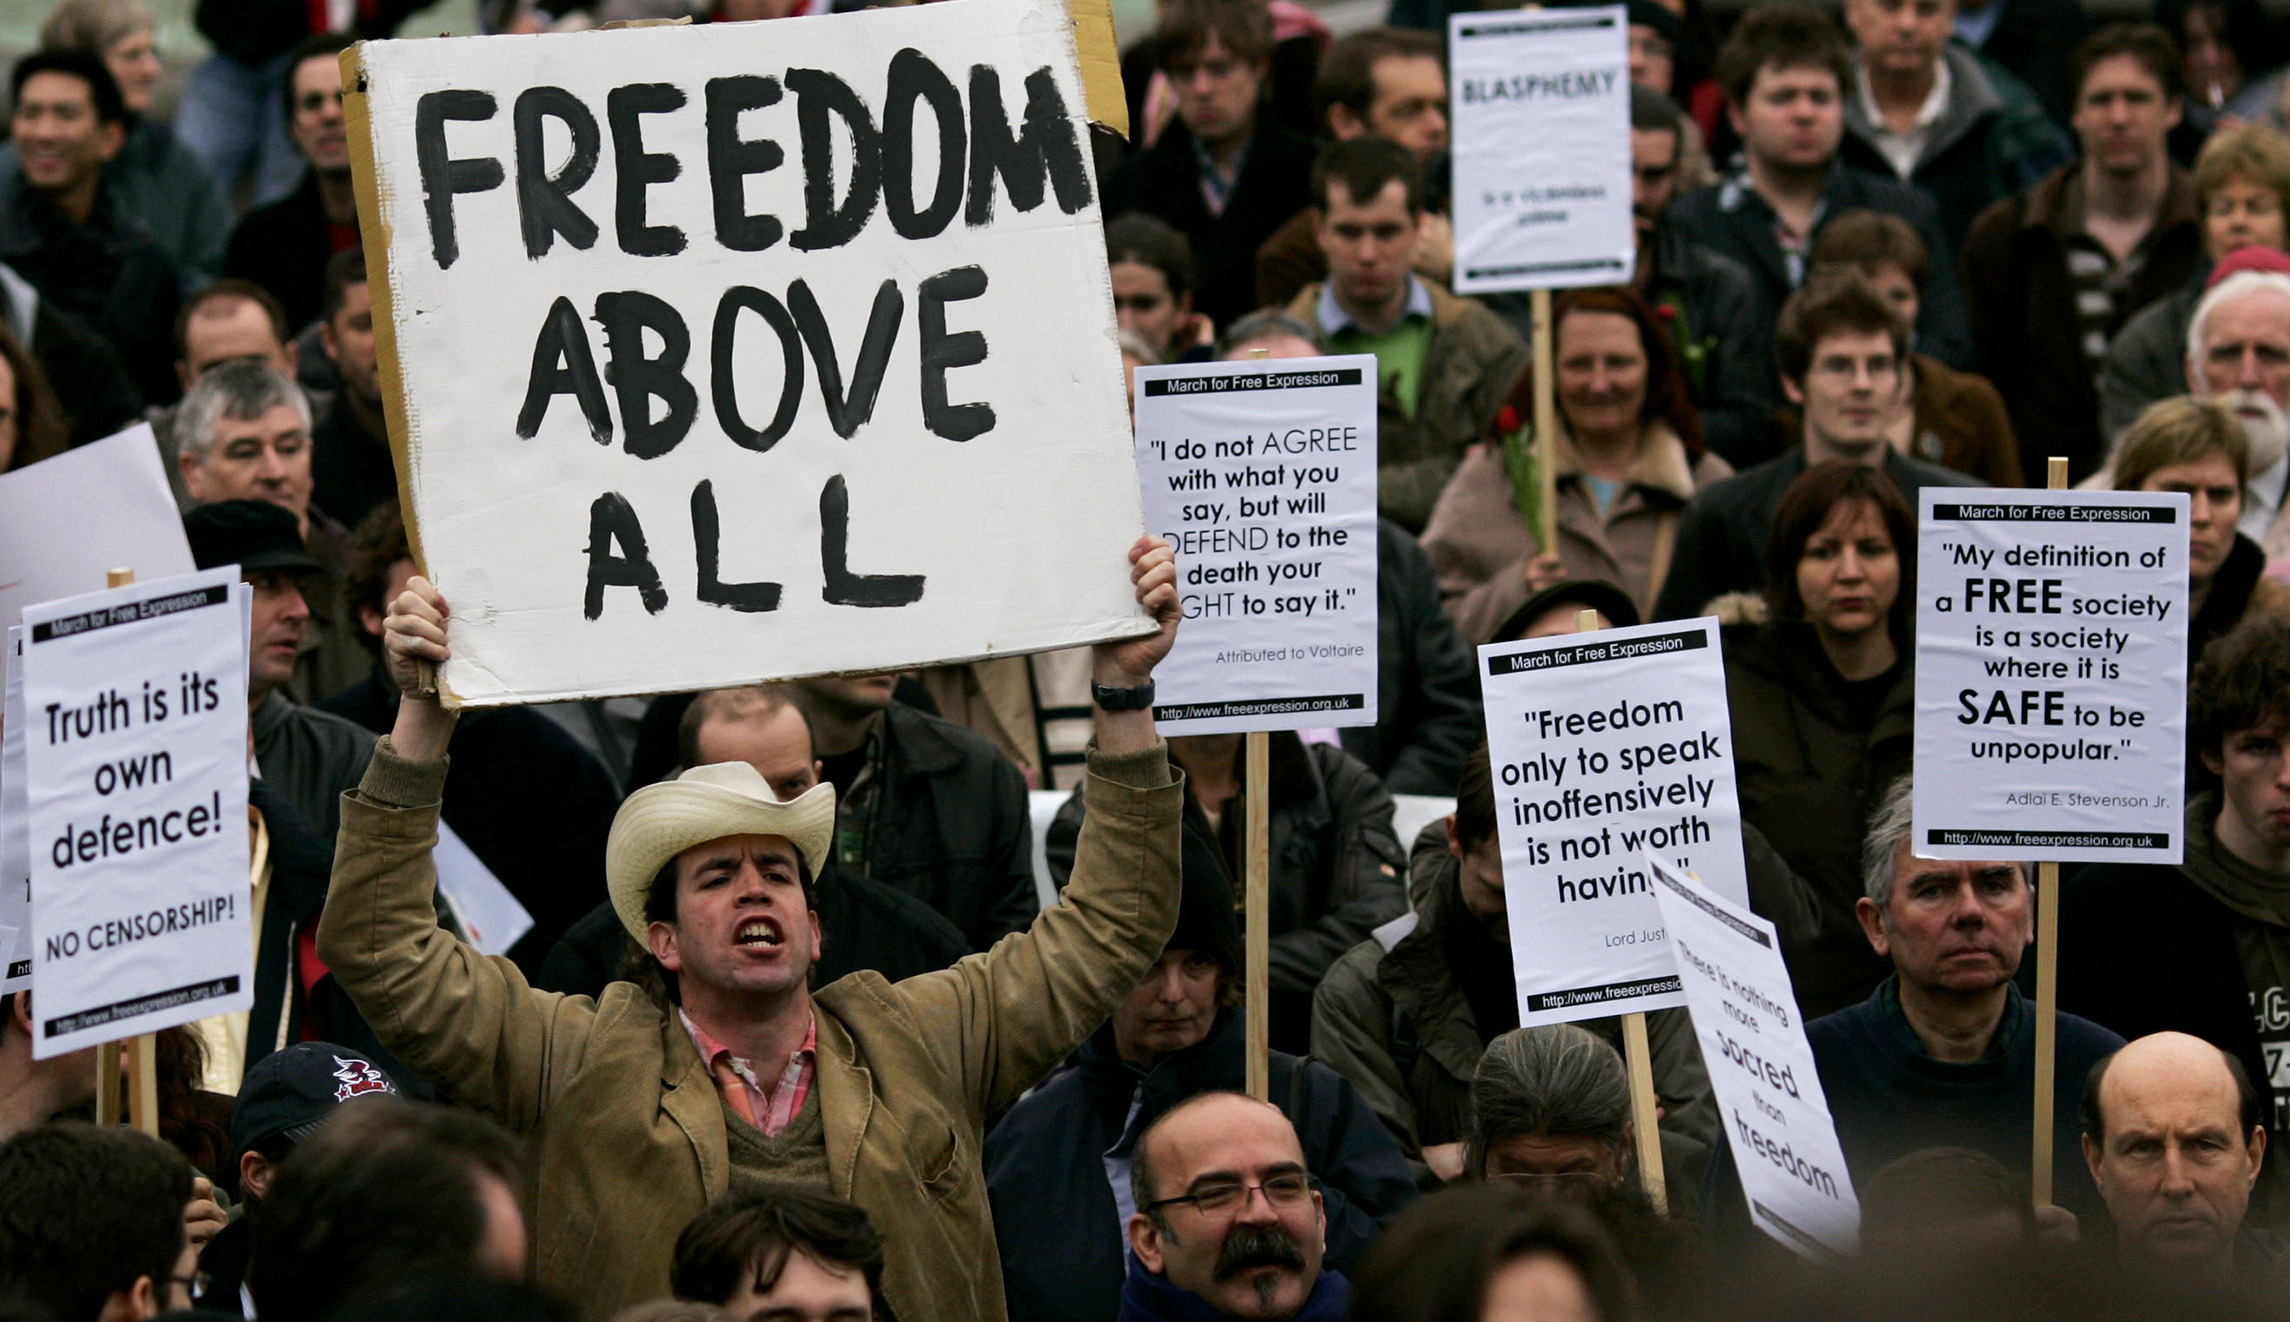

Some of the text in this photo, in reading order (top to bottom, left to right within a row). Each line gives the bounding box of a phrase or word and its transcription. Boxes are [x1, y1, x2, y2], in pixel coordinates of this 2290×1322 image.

[1463, 70, 1617, 104] BLASPHEMY
[415, 47, 1095, 270] FREEDOM
[516, 263, 996, 460] ABOVE
[1167, 372, 1339, 393] March for Free Expression
[1151, 427, 1357, 460] "I do not AGREE
[1168, 464, 1339, 491] with what you
[1182, 492, 1326, 524] say, but will
[1959, 505, 2150, 522] March for Free Expression
[582, 473, 926, 621] ALL
[1163, 526, 1348, 555] DEFEND to the
[1942, 543, 2166, 570] "My definition of
[1187, 561, 1322, 585] death your
[1181, 588, 1356, 619] GHT to say it."
[1935, 578, 2171, 621] a FREE society
[1216, 644, 1364, 664] Attributed to Voltaire
[1511, 637, 1683, 670] March for Free Expression
[1976, 625, 2129, 654] is a society
[1984, 657, 2120, 679] where it is
[46, 671, 219, 745] Truth is its
[1161, 697, 1349, 721] http://www.freeexpression.org.uk
[1524, 700, 1683, 739] "Freedom
[1957, 689, 2145, 727] SAFE to be
[1501, 731, 1722, 787] only to speak
[1971, 739, 2131, 764] unpopular."
[95, 751, 172, 796] own
[1513, 774, 1714, 826] inoffensively
[2006, 793, 2170, 808] Adlai E. Stevenson Jr.
[52, 790, 221, 869] defence!
[1527, 815, 1711, 866] is not worth
[1944, 832, 2153, 848] http://www.freeexpression.org.uk
[46, 894, 235, 962] NO CENSORSHIP!
[1605, 931, 1636, 947] Lord
[1678, 939, 1789, 1028] There is nothing
[1722, 1000, 1760, 1034] more
[1716, 1029, 1800, 1100] sacred
[1752, 1089, 1787, 1127] than
[1734, 1108, 1839, 1199] freedom
